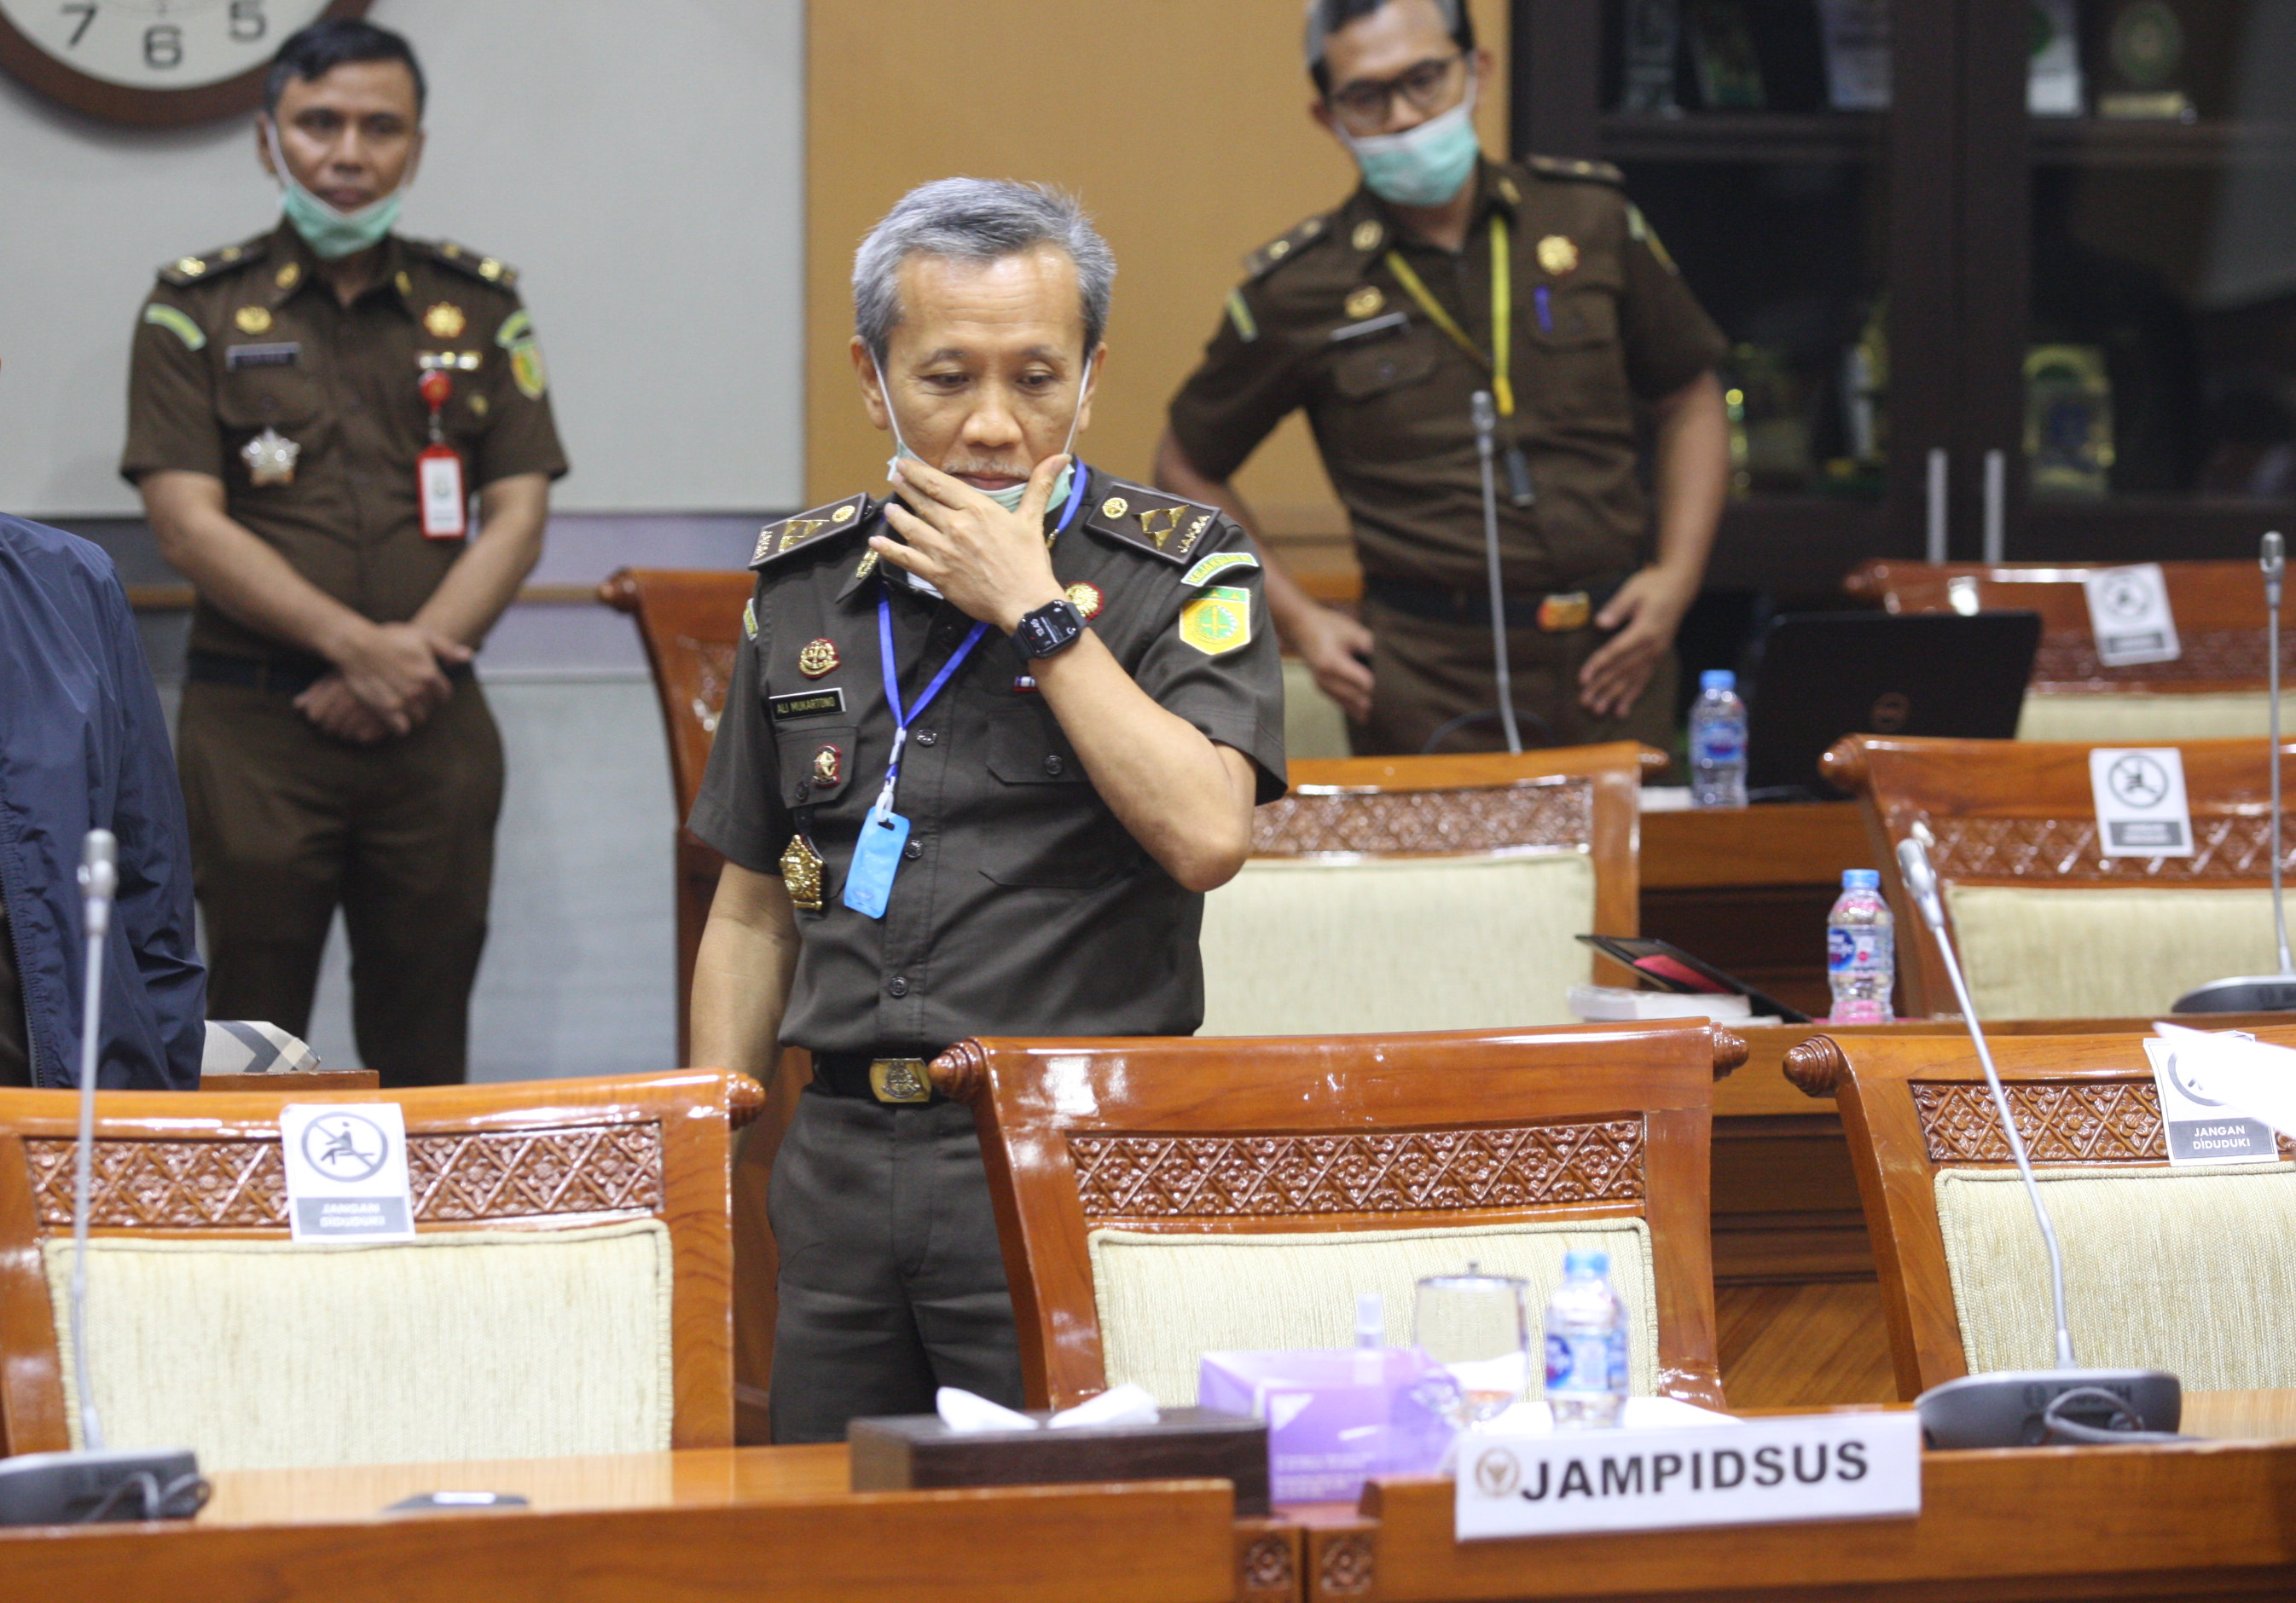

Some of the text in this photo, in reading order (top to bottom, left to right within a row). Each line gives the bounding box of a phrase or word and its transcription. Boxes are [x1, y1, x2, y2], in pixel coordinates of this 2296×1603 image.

[60, 3, 98, 48] 7
[229, 0, 267, 42] 5
[143, 24, 183, 70] 6
[777, 702, 790, 714] ALI
[2192, 1137, 2251, 1150] DIDUDUKI
[2194, 1125, 2246, 1137] JANGAN
[1522, 1441, 1869, 1502] JAMPIDSUS
